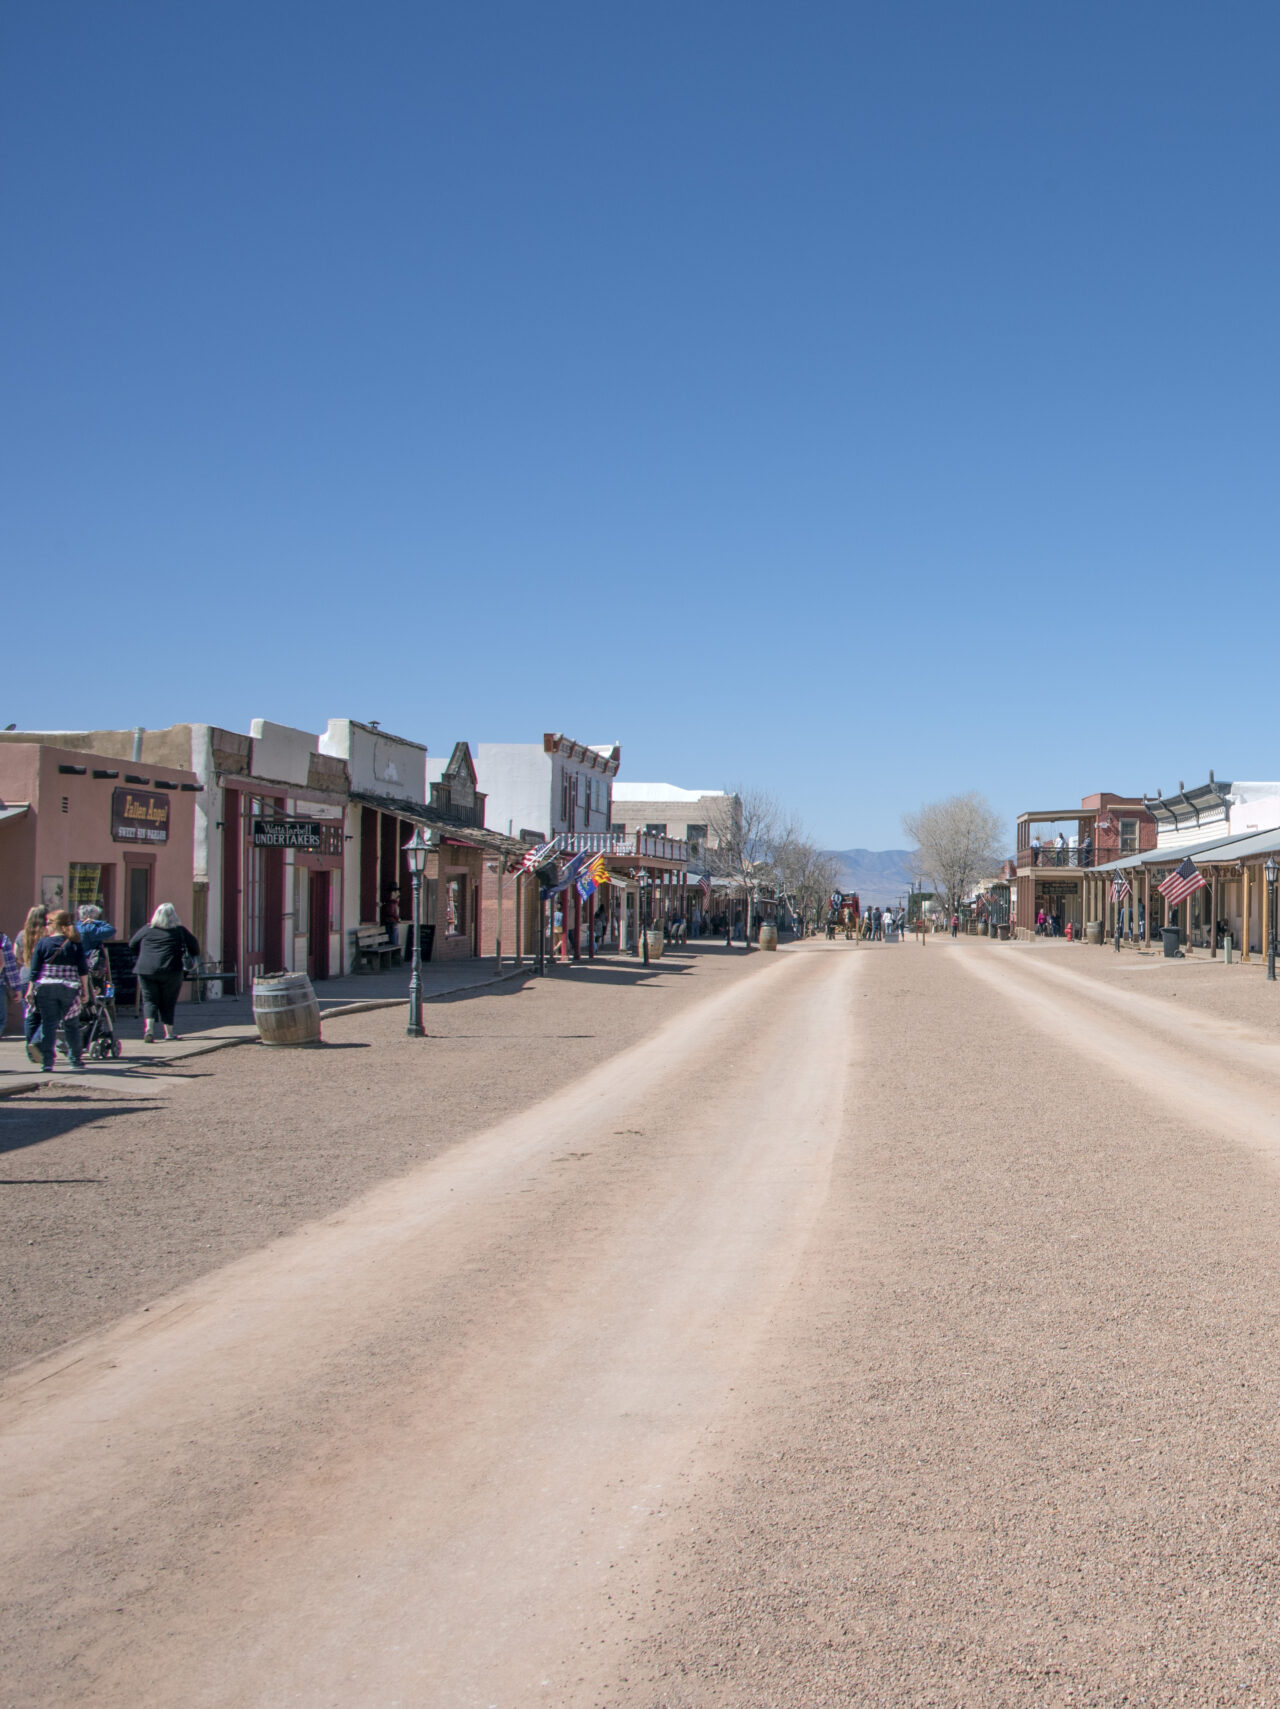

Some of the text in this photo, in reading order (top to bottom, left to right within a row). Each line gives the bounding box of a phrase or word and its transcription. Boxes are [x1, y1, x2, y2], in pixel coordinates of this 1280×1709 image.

[124, 795, 168, 826] Fallen Angel
[255, 833, 320, 847] UNDERTAKERS
